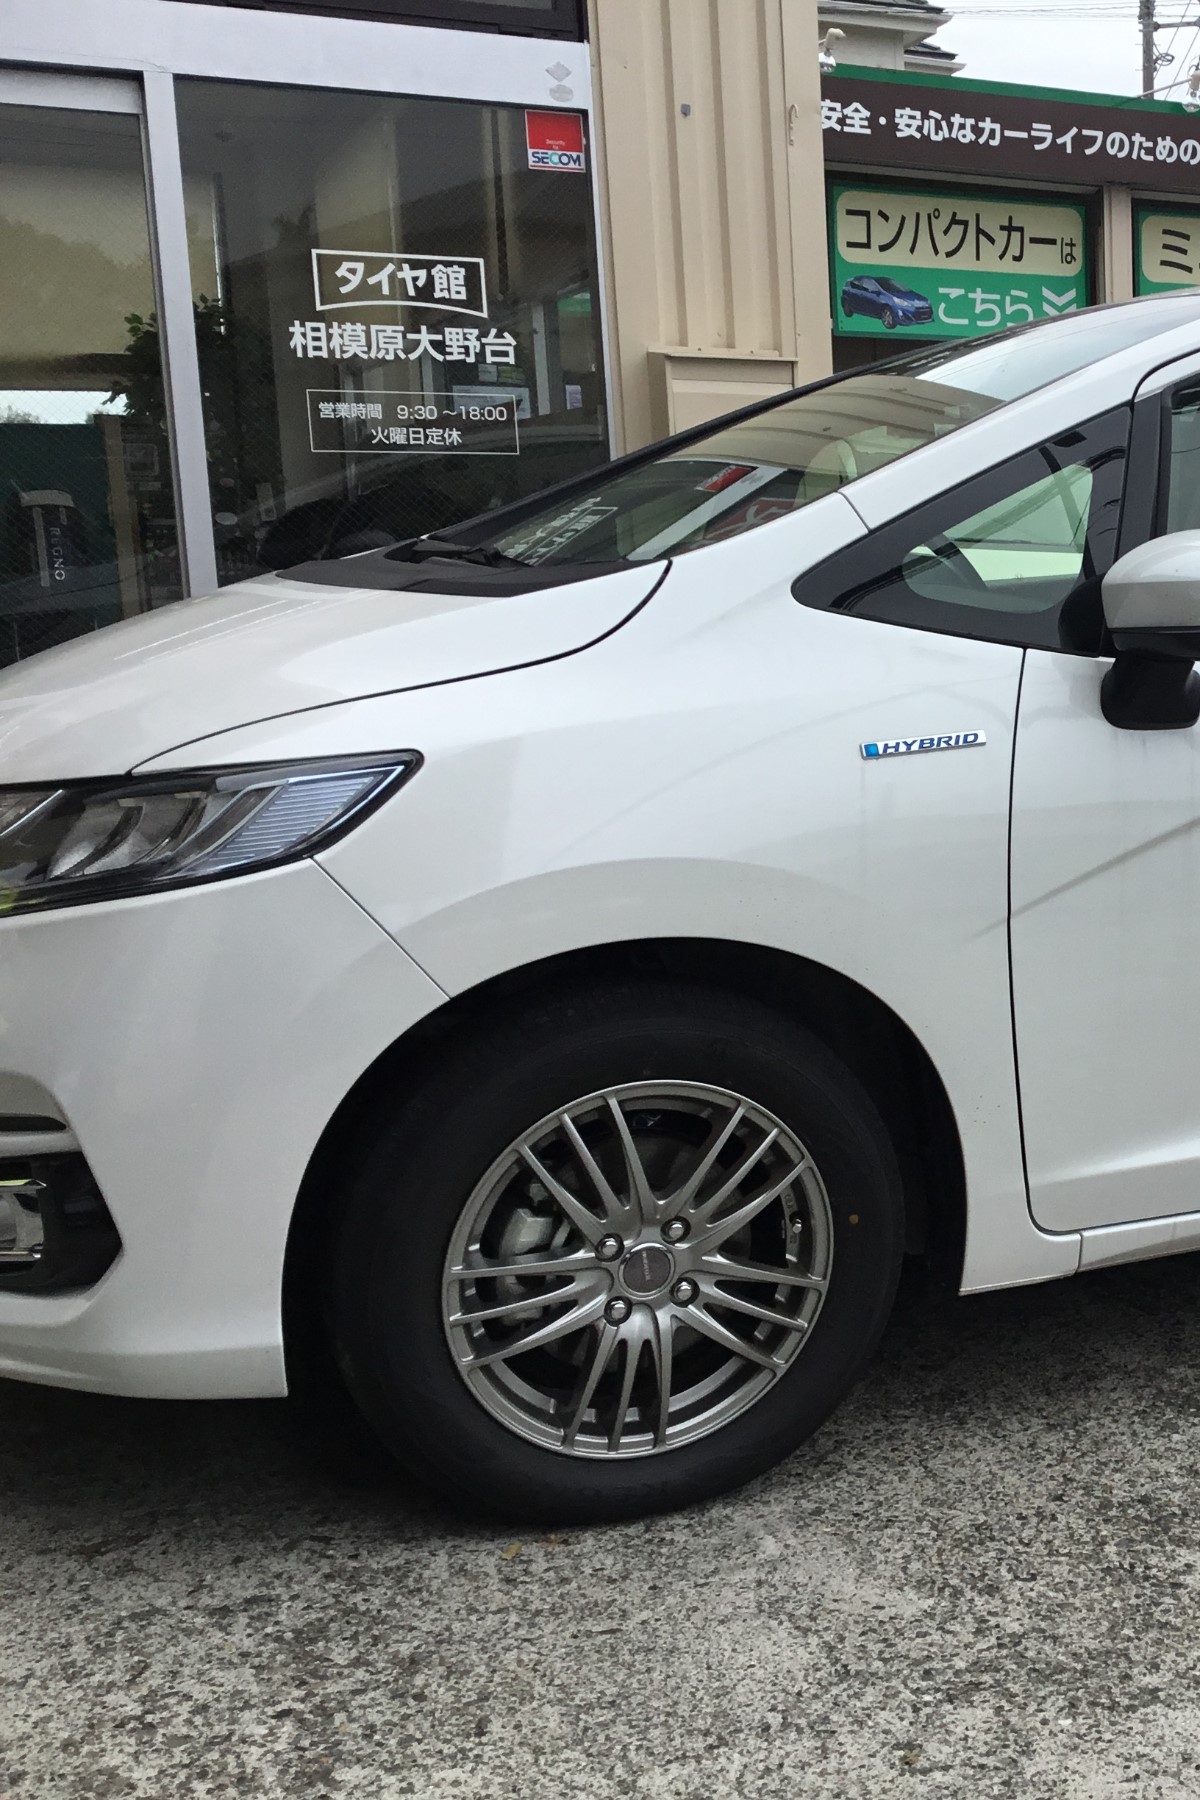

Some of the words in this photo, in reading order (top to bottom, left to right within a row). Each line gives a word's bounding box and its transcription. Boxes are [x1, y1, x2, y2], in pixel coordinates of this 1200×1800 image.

[531, 151, 582, 167] SECOM
[845, 208, 1077, 265] コンパクトカーは
[334, 261, 467, 300] タイヤ館
[938, 286, 1034, 328] こちら
[289, 320, 517, 365] 相模原大野台
[318, 401, 383, 420] 営業時間
[371, 426, 463, 445] 火曜日定休
[882, 732, 979, 754] HYBRID
